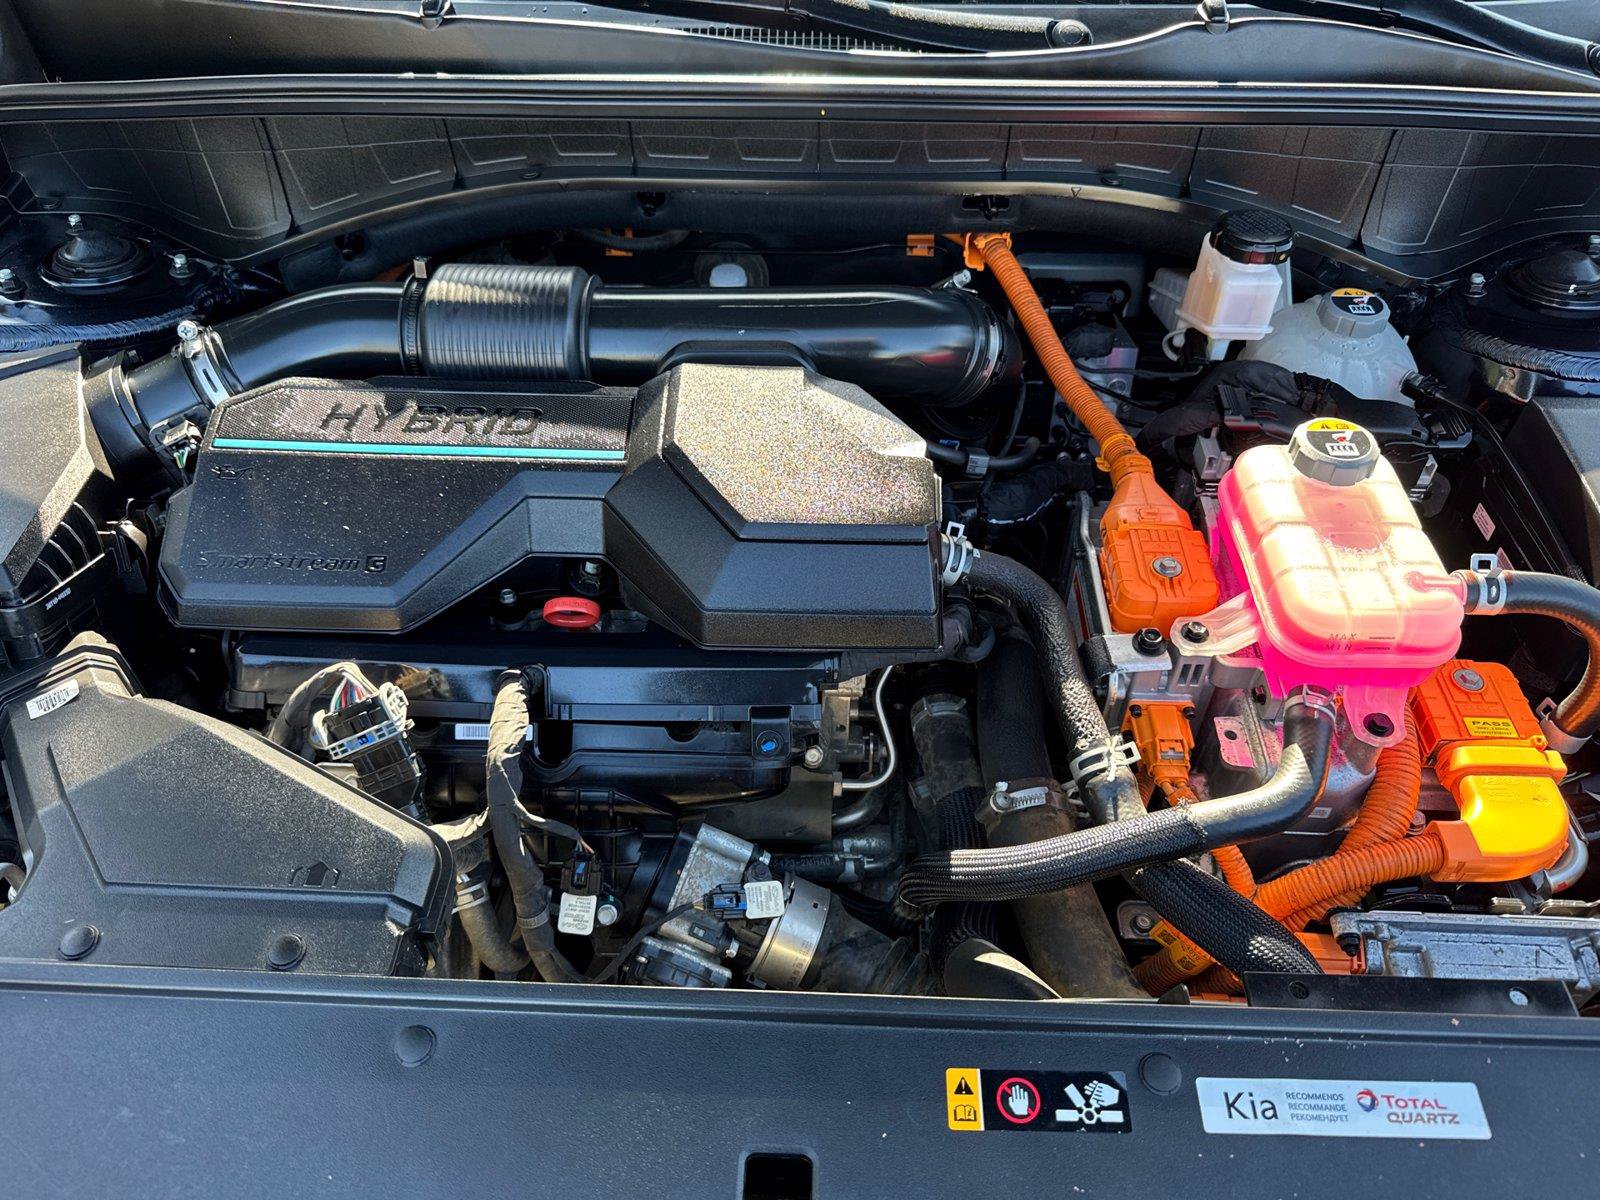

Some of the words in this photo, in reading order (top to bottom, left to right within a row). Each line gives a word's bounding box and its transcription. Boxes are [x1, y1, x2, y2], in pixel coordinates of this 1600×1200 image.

[319, 401, 544, 435] HYBRID
[195, 551, 360, 572] Smartstream
[1328, 633, 1359, 641] MAX
[1325, 643, 1353, 651] MIN
[1471, 720, 1511, 728] PASS
[1285, 1091, 1344, 1101] RECOMMENDS
[1222, 1091, 1279, 1121] Kia
[1287, 1102, 1347, 1112] RECOMMANDE
[1381, 1094, 1448, 1110] TOTAL
[1290, 1112, 1349, 1123] РЕКОМЕНДУЕТ
[1387, 1111, 1461, 1125] QUARTZ
